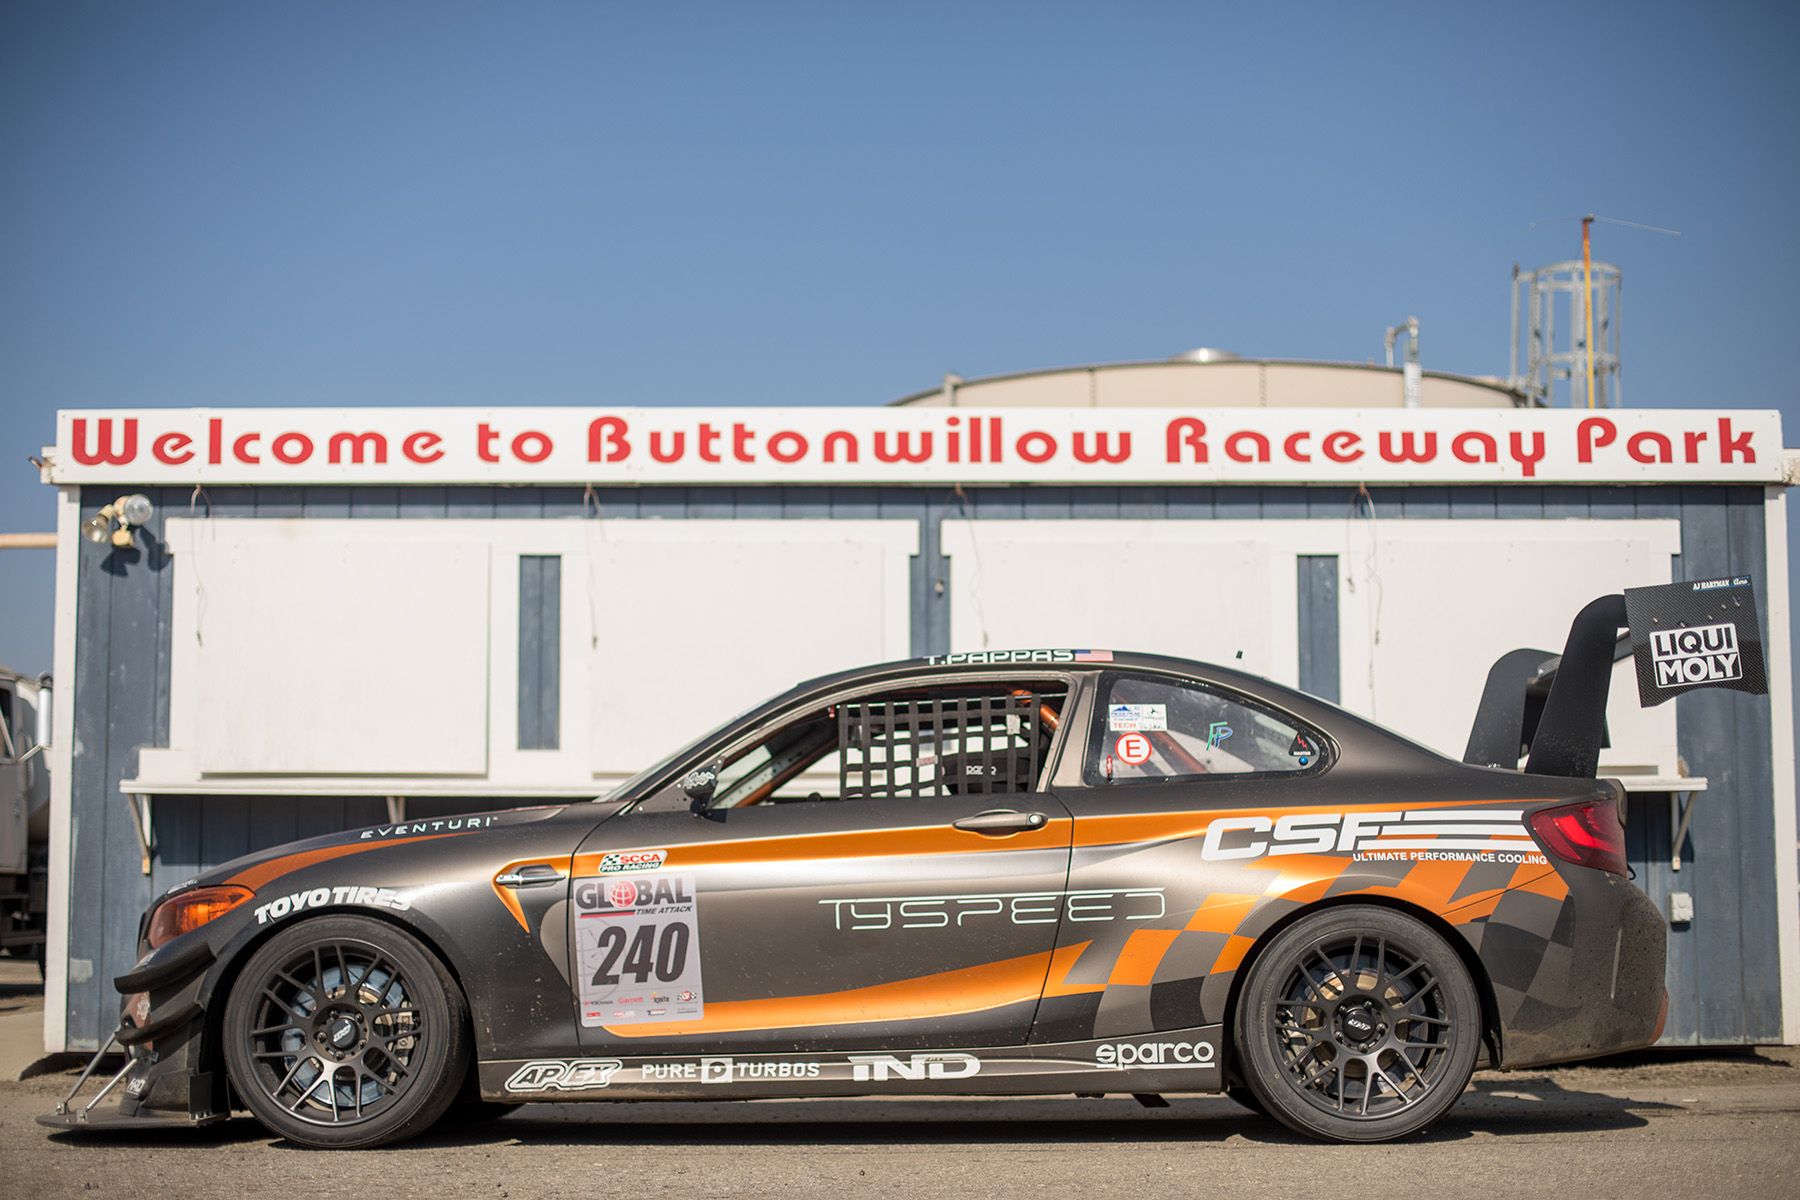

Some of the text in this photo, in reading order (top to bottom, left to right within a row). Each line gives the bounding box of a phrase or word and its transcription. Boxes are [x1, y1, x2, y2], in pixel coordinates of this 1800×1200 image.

[71, 415, 1756, 478] Welcome to Buttonwillow Raceway Park
[1654, 626, 1734, 657] LIQUI
[1658, 653, 1738, 685] MOLY
[1125, 739, 1142, 758] E
[360, 816, 491, 839] EVENTURI
[1200, 810, 1403, 862] CSF
[602, 862, 660, 872] PRO RACING
[620, 853, 661, 864] SCCA
[1352, 851, 1548, 865] ULTIMATE PERFORMANCE COOLING
[254, 885, 411, 925] TOYO TIRES
[636, 906, 693, 916] TIME ATTACK
[591, 921, 690, 986] 240
[1095, 1041, 1215, 1071] sparco
[509, 1061, 621, 1090] APEX
[641, 1063, 697, 1080] PURE
[738, 1062, 820, 1078] TURBOS
